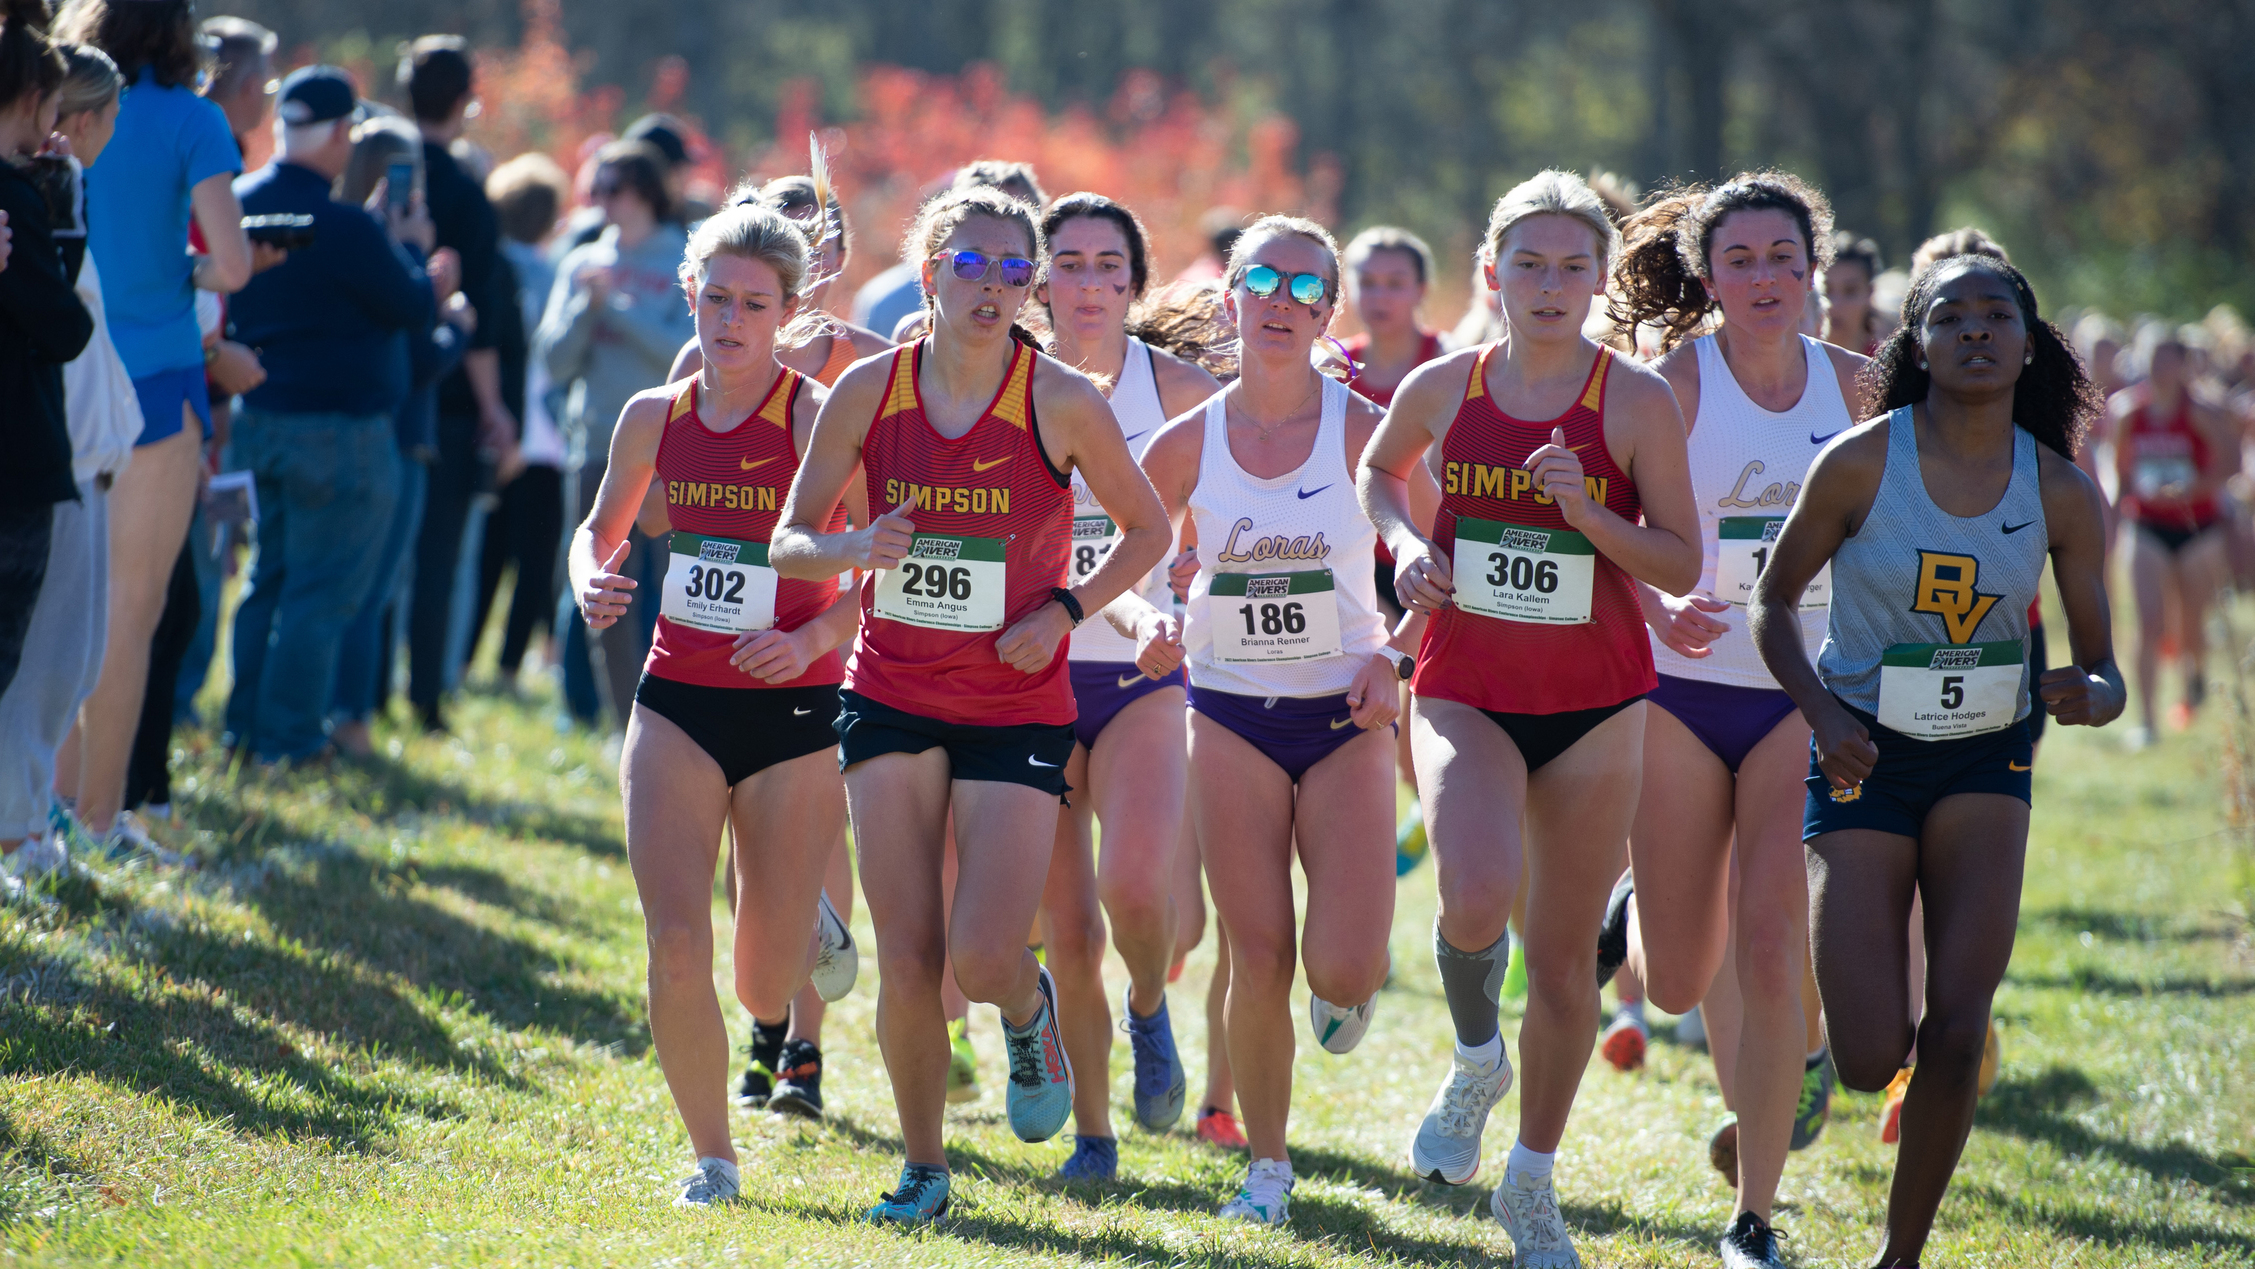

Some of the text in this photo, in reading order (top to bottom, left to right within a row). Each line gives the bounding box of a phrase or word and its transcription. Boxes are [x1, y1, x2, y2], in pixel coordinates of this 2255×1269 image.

[1446, 461, 1608, 507] SIMPN
[1718, 460, 1801, 508] Lor
[669, 480, 776, 511] SIMPSON
[885, 478, 1010, 514] SIMPSON
[1218, 517, 1331, 562] Loras
[1505, 529, 1548, 540] AMERICAN
[702, 542, 738, 552] AMERICAN
[917, 539, 960, 548] AMERICAN
[1502, 536, 1545, 549] RIVERS
[700, 548, 736, 560] RIVERS
[915, 546, 958, 558] RIVERS
[1486, 552, 1558, 593] 306
[685, 565, 746, 605] 302
[902, 563, 971, 600] 296
[1248, 585, 1287, 597] RIVERS
[1493, 589, 1550, 604] Lara Kallem
[1908, 548, 2006, 644] BV
[687, 599, 741, 615] Emily Erhardt
[906, 597, 968, 612] Emma Angus
[1496, 601, 1543, 613] Simpson (Iowa)
[692, 612, 714, 620] Simpson
[913, 610, 939, 619] Simpson
[1239, 602, 1306, 635] 186
[1241, 636, 1310, 646] Brianna Renner
[1936, 649, 1980, 657] AMERICAN
[1934, 656, 1978, 669] RIVERS
[1940, 676, 1964, 709] 5
[1914, 710, 1986, 721] Latrice Hodges
[1041, 1022, 1066, 1083] HOKA
